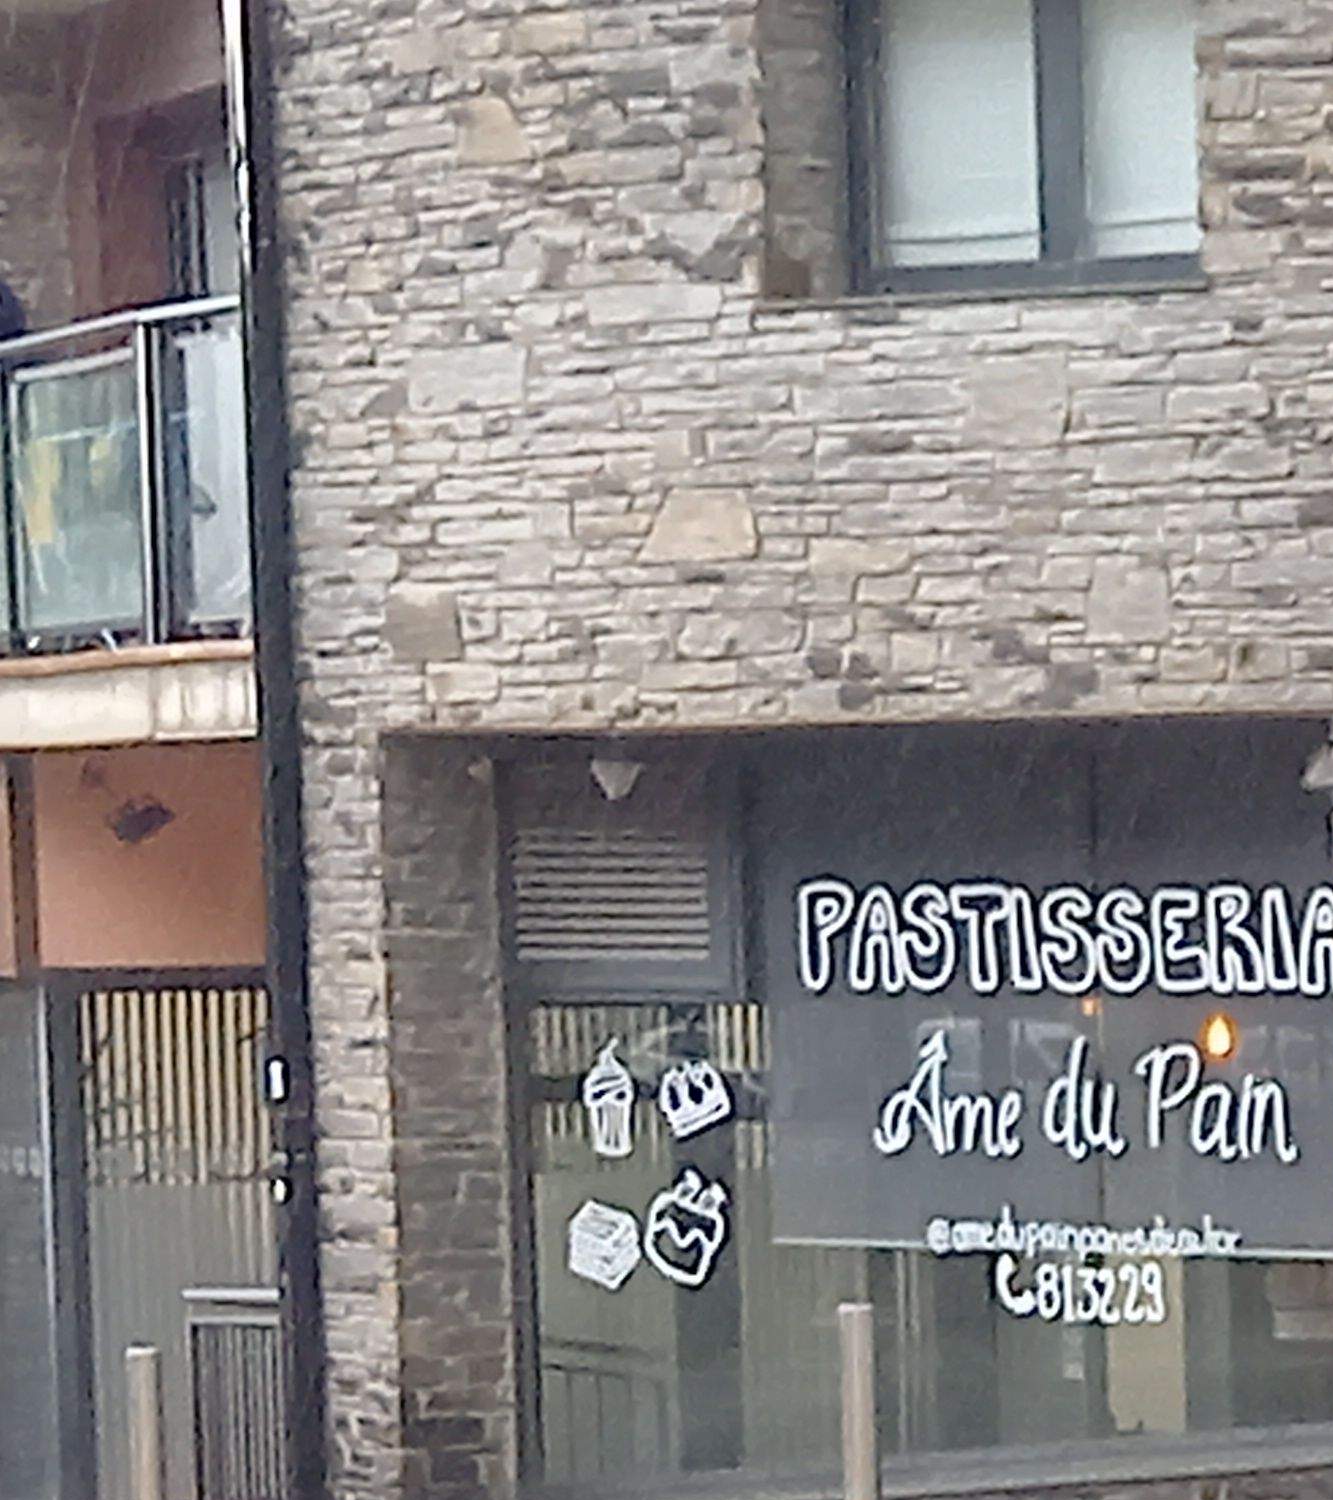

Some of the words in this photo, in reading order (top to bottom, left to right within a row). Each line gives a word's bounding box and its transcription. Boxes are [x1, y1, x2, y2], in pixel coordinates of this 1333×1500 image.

[874, 1029, 1021, 1156] Âme
[1043, 1035, 1125, 1160] du
[1135, 1043, 1298, 1163] Pain
[1036, 1262, 1166, 1324] 813229
